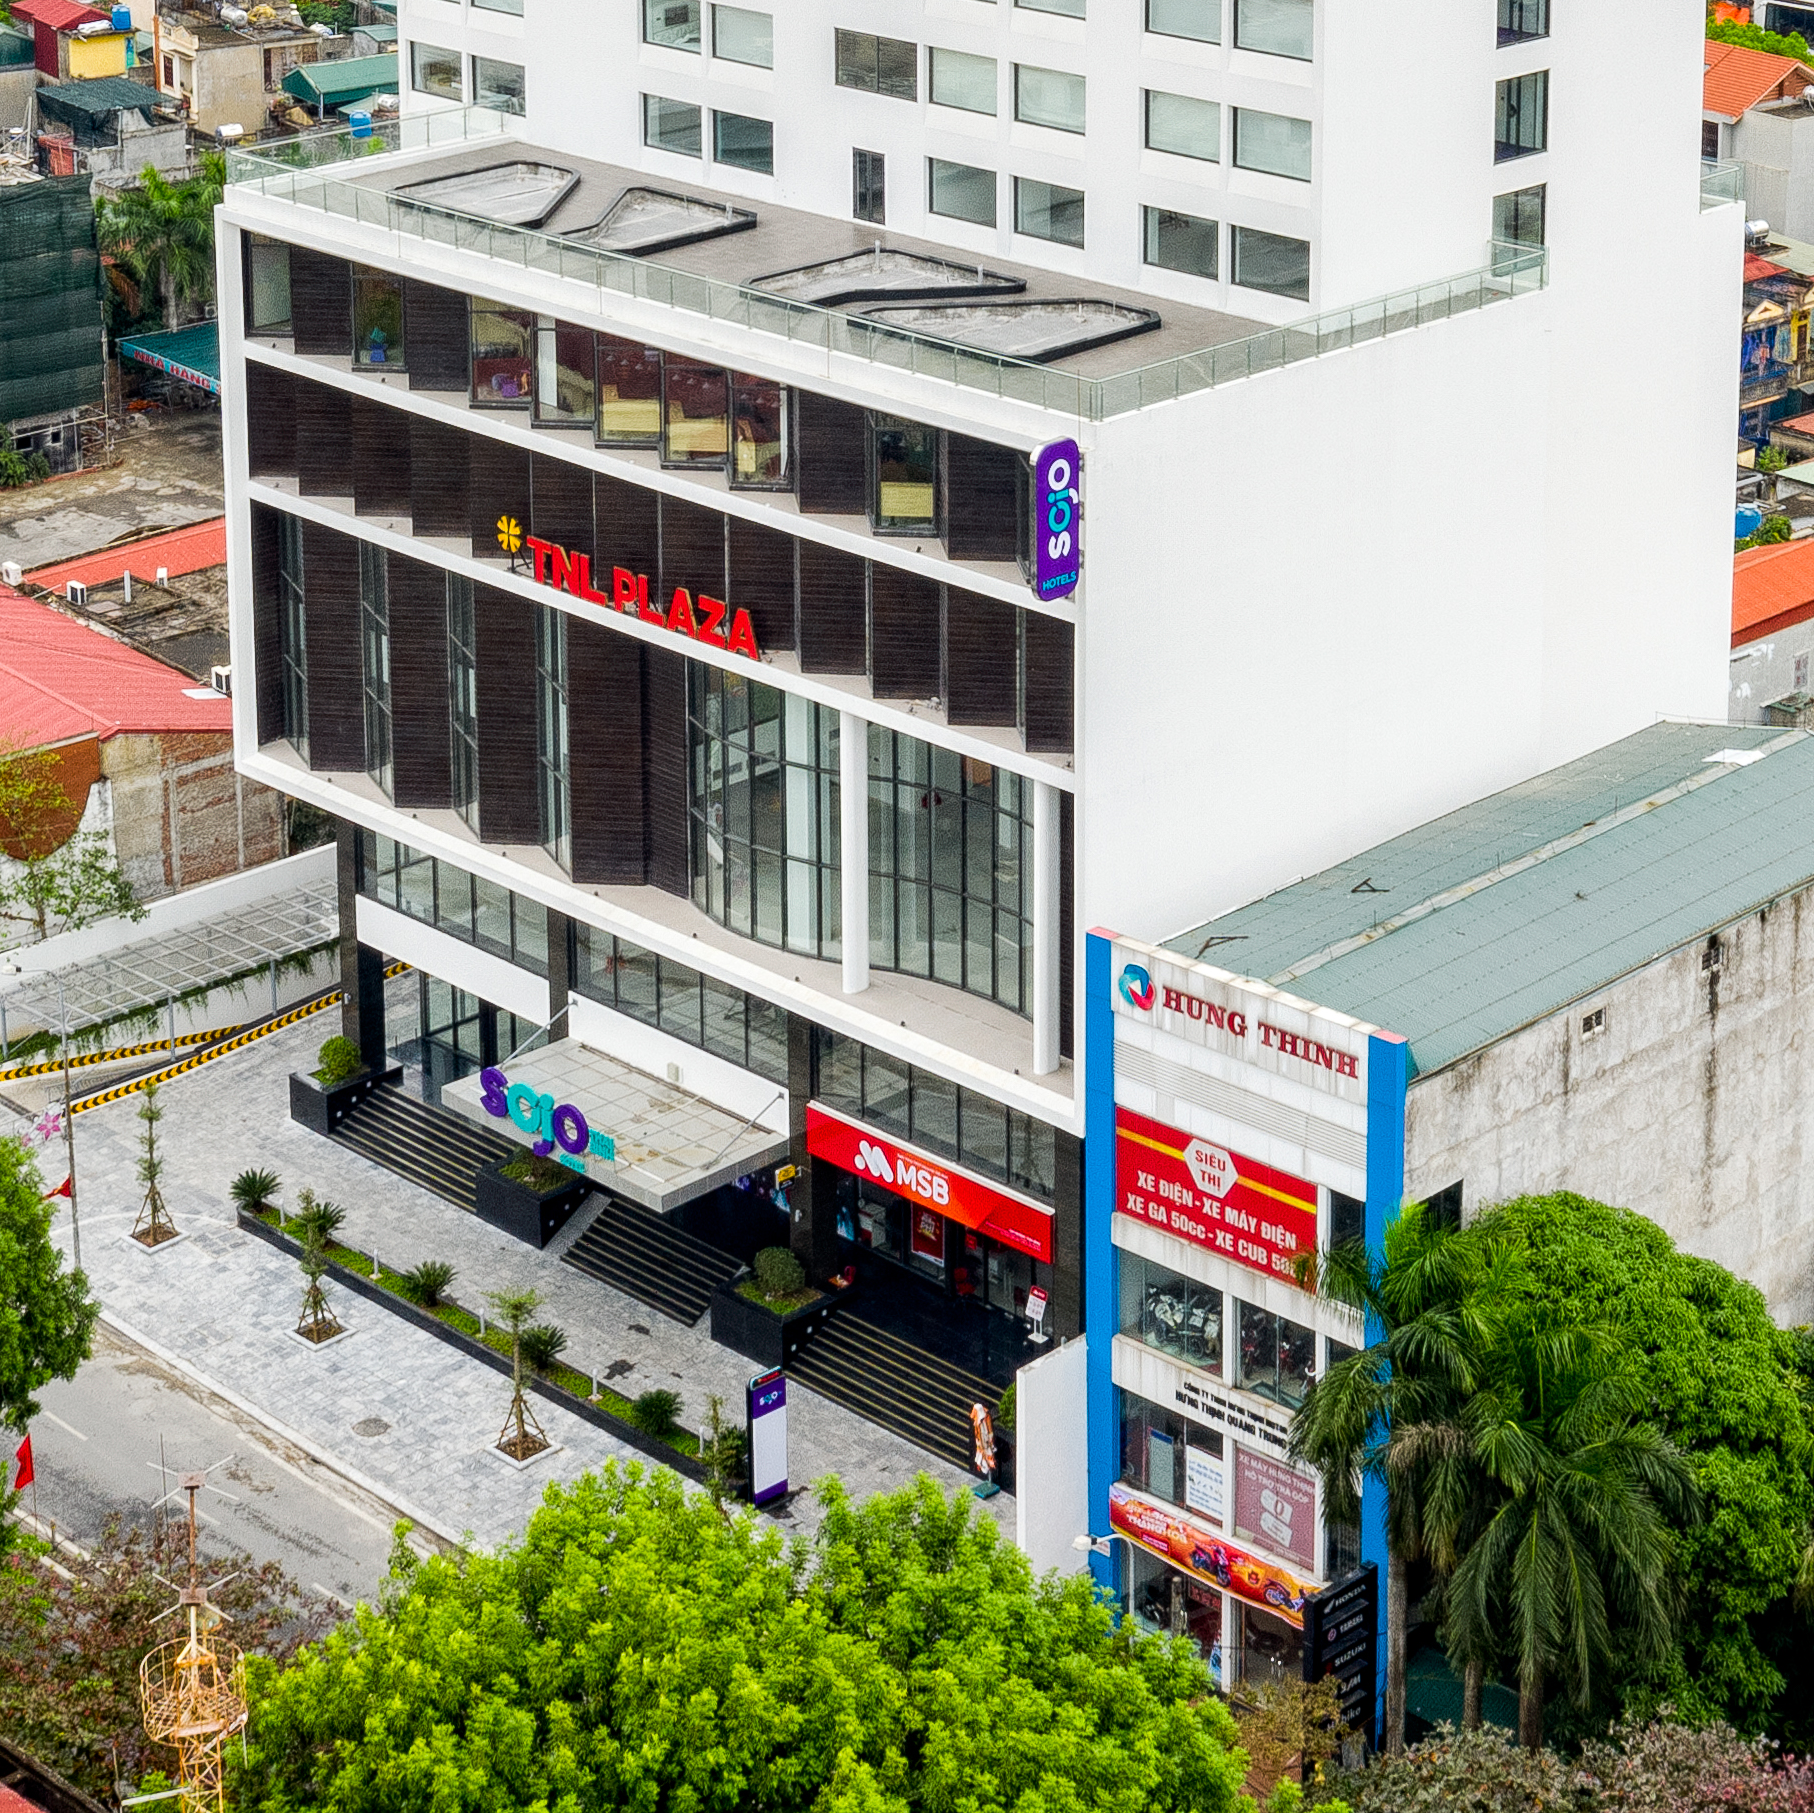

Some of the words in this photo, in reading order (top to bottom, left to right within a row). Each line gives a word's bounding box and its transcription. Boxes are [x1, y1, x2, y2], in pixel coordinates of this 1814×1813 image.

[527, 535, 608, 607] TNL
[613, 566, 761, 661] PLAZA
[1042, 571, 1077, 591] HOTELS
[1163, 986, 1248, 1038] HUNG
[1258, 1020, 1359, 1080] THINH
[1195, 1149, 1226, 1172] SIÊU
[896, 1159, 949, 1205] MSB
[1200, 1170, 1221, 1191] THỊ
[1126, 1192, 1145, 1214] XE
[1148, 1202, 1168, 1224] GA
[1214, 1229, 1234, 1252] XE
[1237, 1239, 1268, 1265] CUB
[1137, 1170, 1156, 1192] XE
[1159, 1178, 1193, 1207] ĐIỆN
[1202, 1197, 1221, 1220] XE
[1225, 1205, 1258, 1234] MÁY
[1260, 1221, 1297, 1251] ĐIỆN
[1227, 1413, 1256, 1436] QUANG
[1258, 1426, 1287, 1450] TRUNG
[1335, 1584, 1366, 1608] HONDA
[1334, 1642, 1367, 1667] SUZUKI
